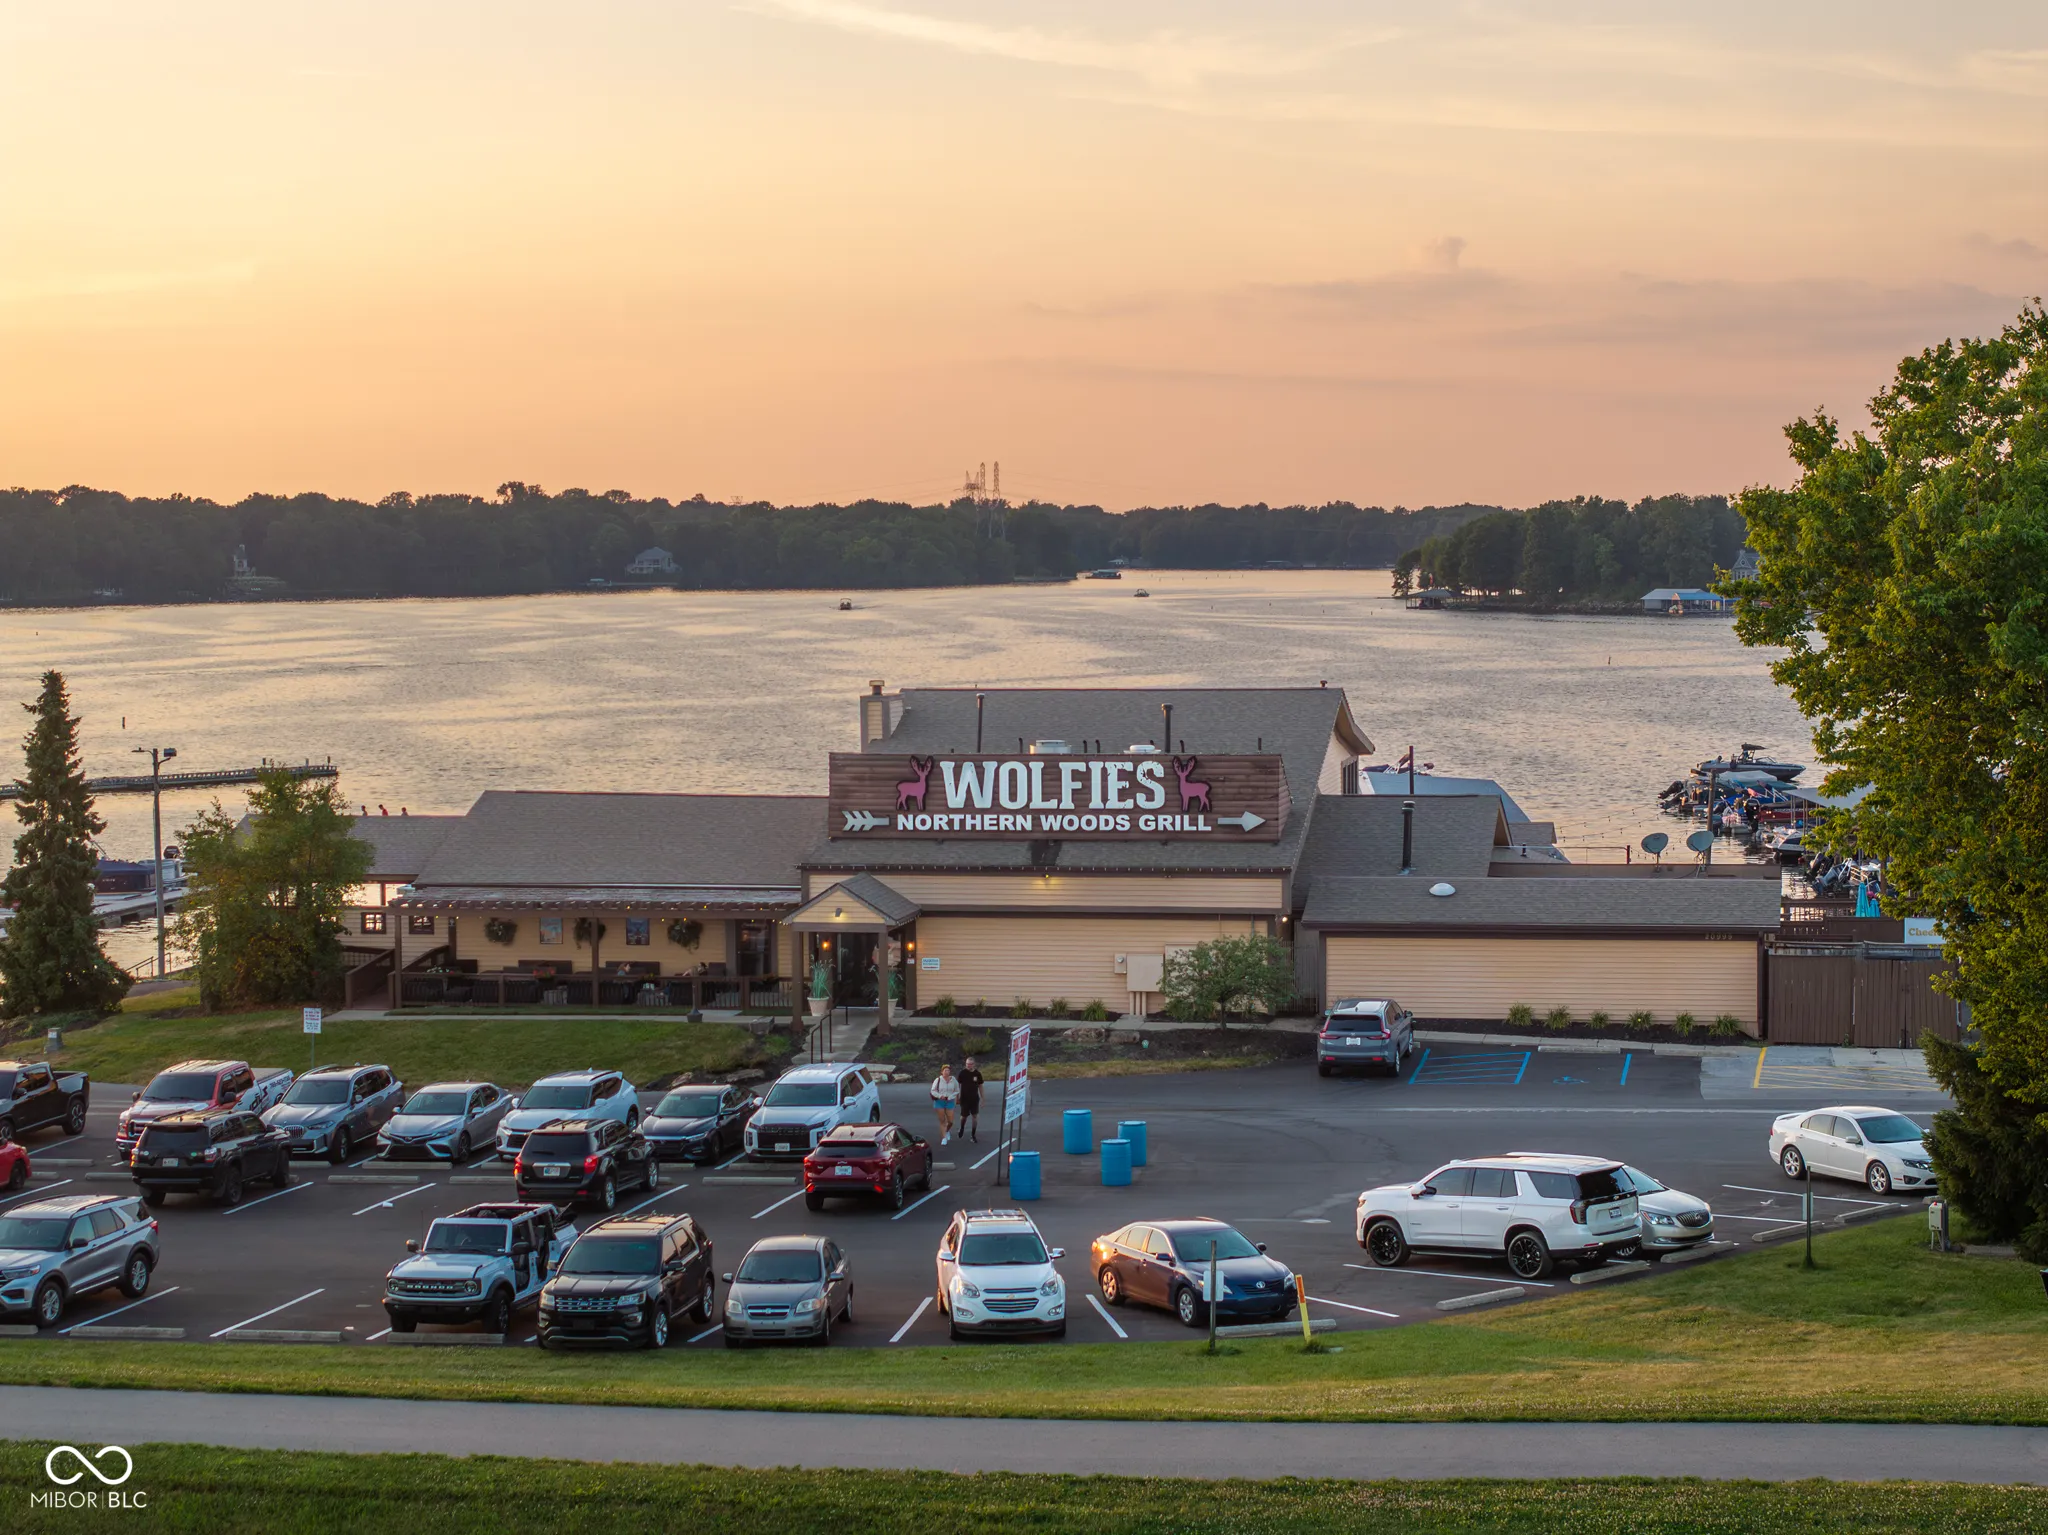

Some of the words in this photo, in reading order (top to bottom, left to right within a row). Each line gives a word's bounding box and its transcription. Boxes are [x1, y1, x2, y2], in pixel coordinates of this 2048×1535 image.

[940, 760, 1165, 810] WOLFIES
[897, 813, 1032, 831] NORTHERN
[1040, 813, 1130, 831] WOODS
[1138, 813, 1212, 831] GRILL
